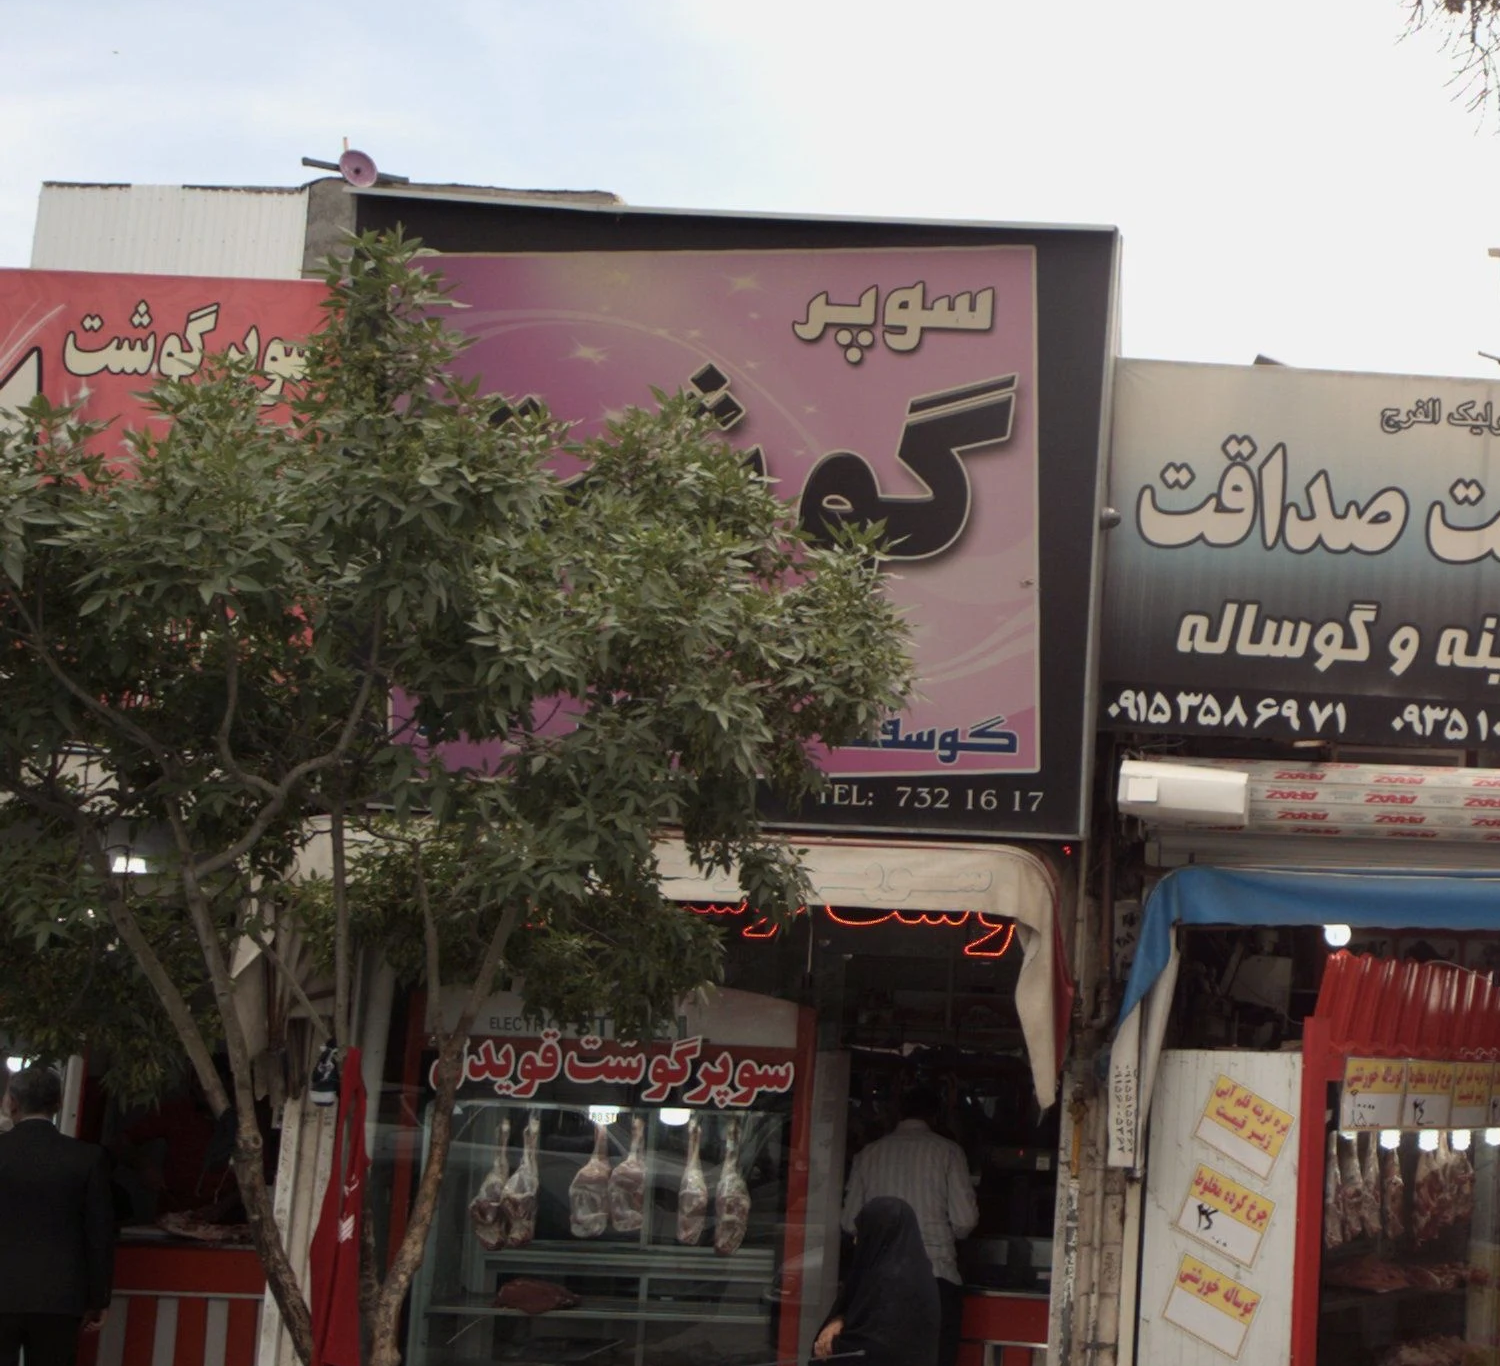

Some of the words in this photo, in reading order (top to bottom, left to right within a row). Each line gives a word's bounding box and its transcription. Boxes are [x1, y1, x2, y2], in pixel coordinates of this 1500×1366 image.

[63, 299, 220, 383] گوشت
[794, 281, 995, 365] سوپر
[1380, 397, 1442, 434] الفرج
[1136, 435, 1409, 553] صداقت
[1176, 603, 1380, 673] گوساله
[1389, 625, 1419, 676] و
[818, 784, 874, 806] TEL:
[896, 786, 950, 808] 732
[966, 788, 998, 811] 16
[1012, 790, 1044, 812] 17
[564, 1034, 703, 1102] گوشت
[684, 1051, 795, 1108] سوپر
